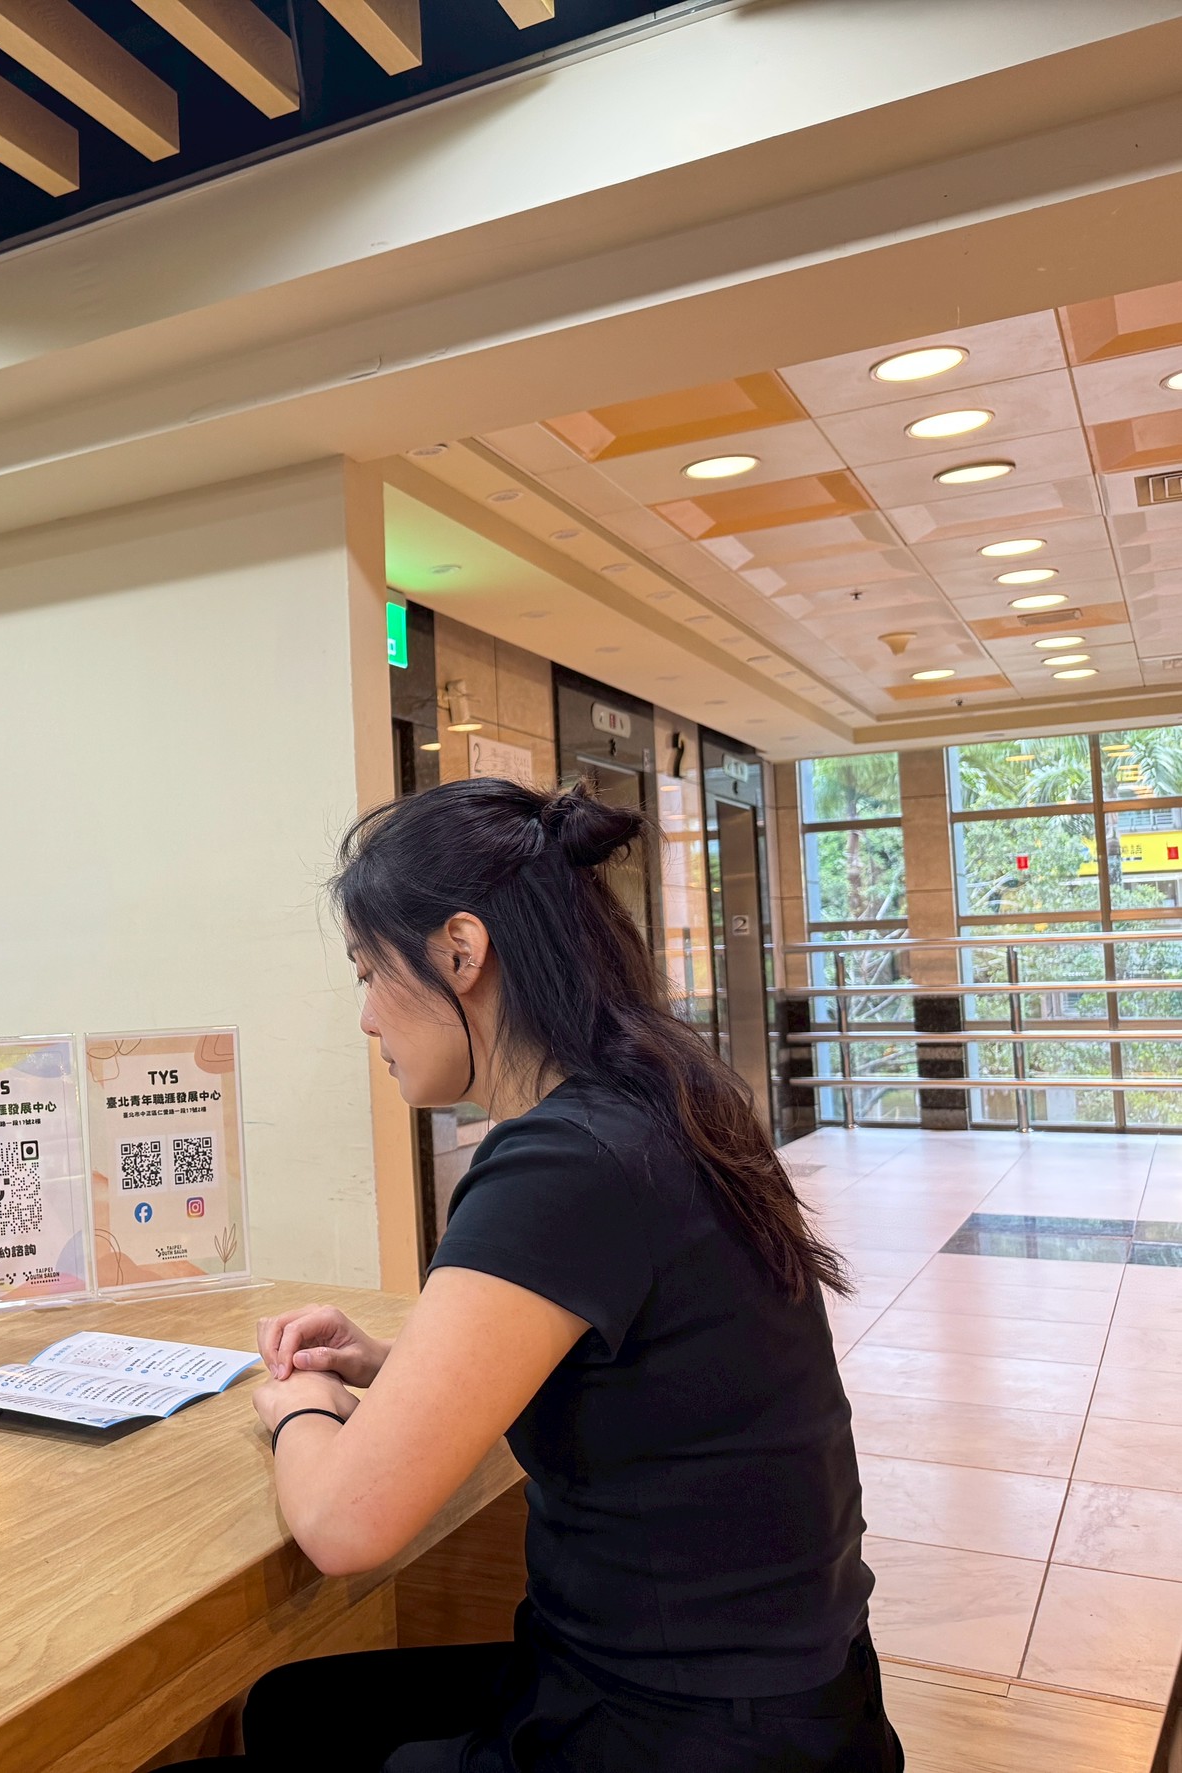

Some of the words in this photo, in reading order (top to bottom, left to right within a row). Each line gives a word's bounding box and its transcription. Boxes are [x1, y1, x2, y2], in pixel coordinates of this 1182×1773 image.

[473, 743, 482, 773] 2
[734, 916, 748, 932] 2
[147, 1069, 179, 1085] TYS
[106, 1089, 221, 1109] 臺北青年職涯發展中心
